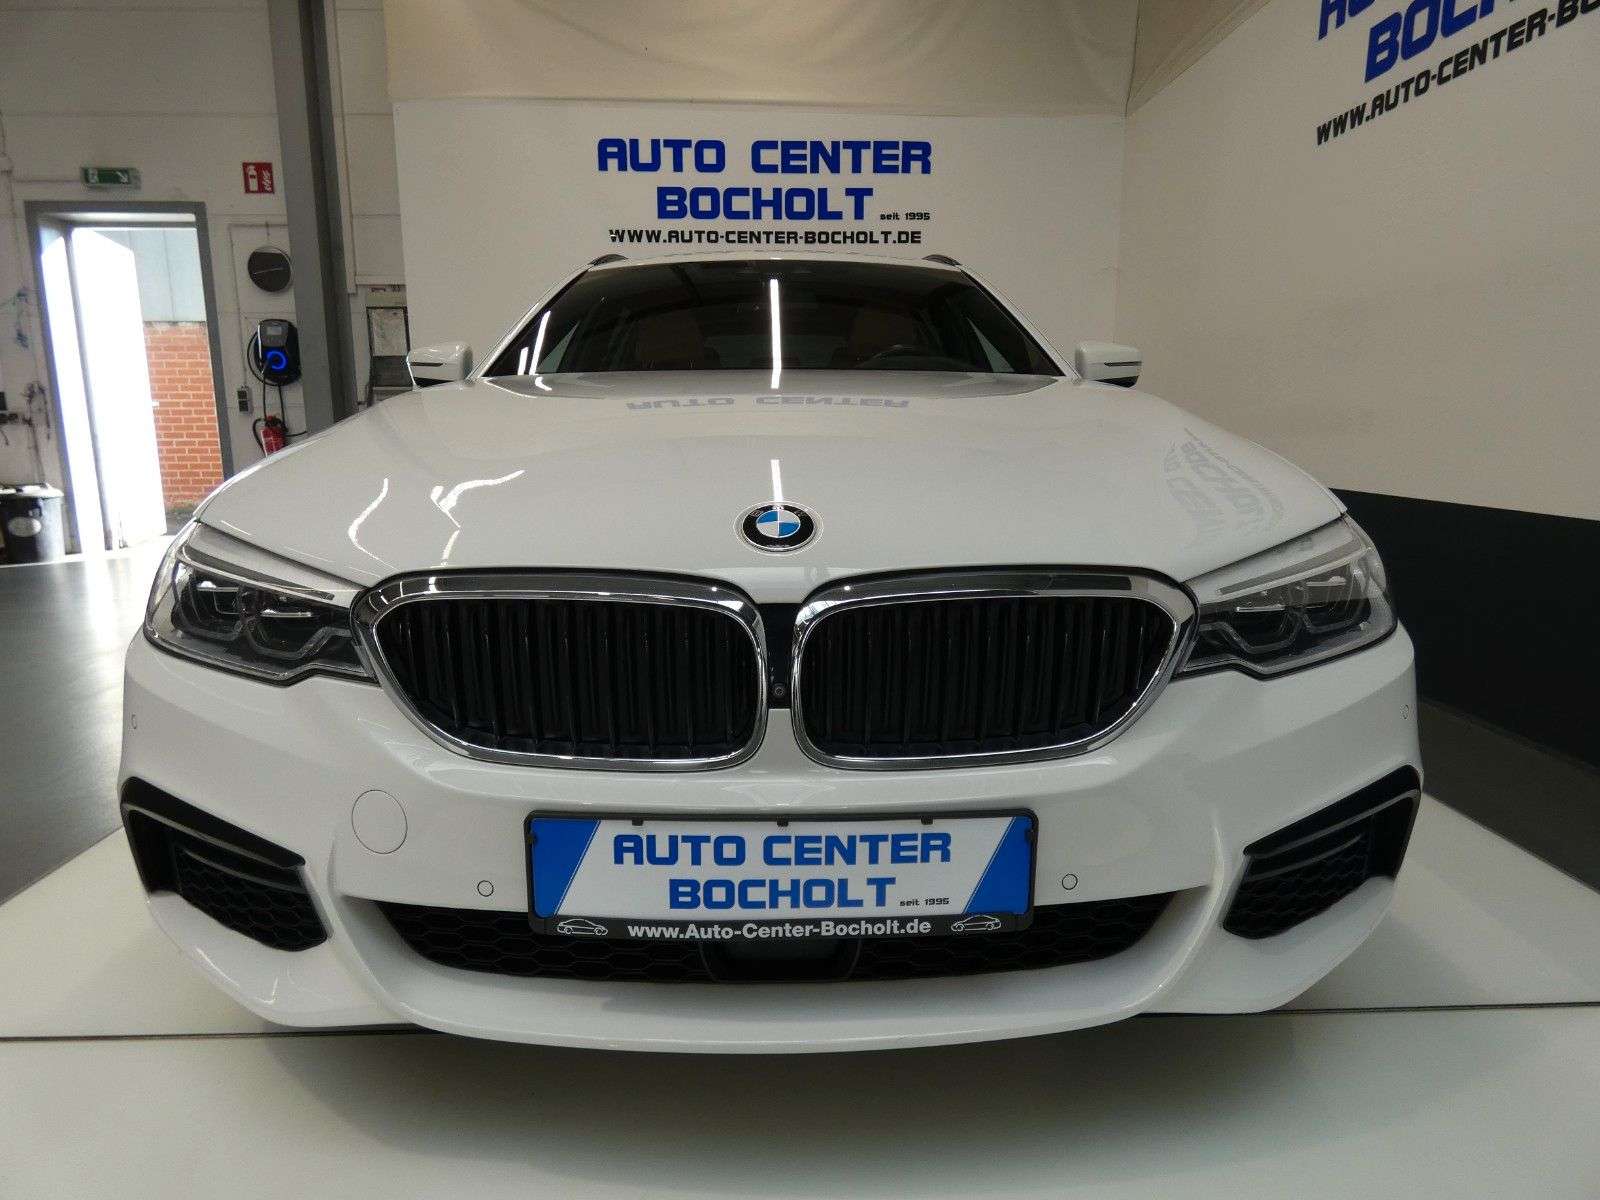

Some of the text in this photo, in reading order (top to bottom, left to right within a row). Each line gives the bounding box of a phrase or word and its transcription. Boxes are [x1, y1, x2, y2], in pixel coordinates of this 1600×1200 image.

[597, 138, 932, 175] AUTO CENTER
[656, 187, 931, 221] BOCHOLT seit 1995
[609, 229, 922, 245] WWW.AUTO-CENTER-BOCHOLT.DE
[613, 833, 952, 867] AUTO CENTER
[668, 876, 950, 911] BOCHOLT seit 1995
[627, 918, 932, 939] www.Auto-Center-Bocholt.de
